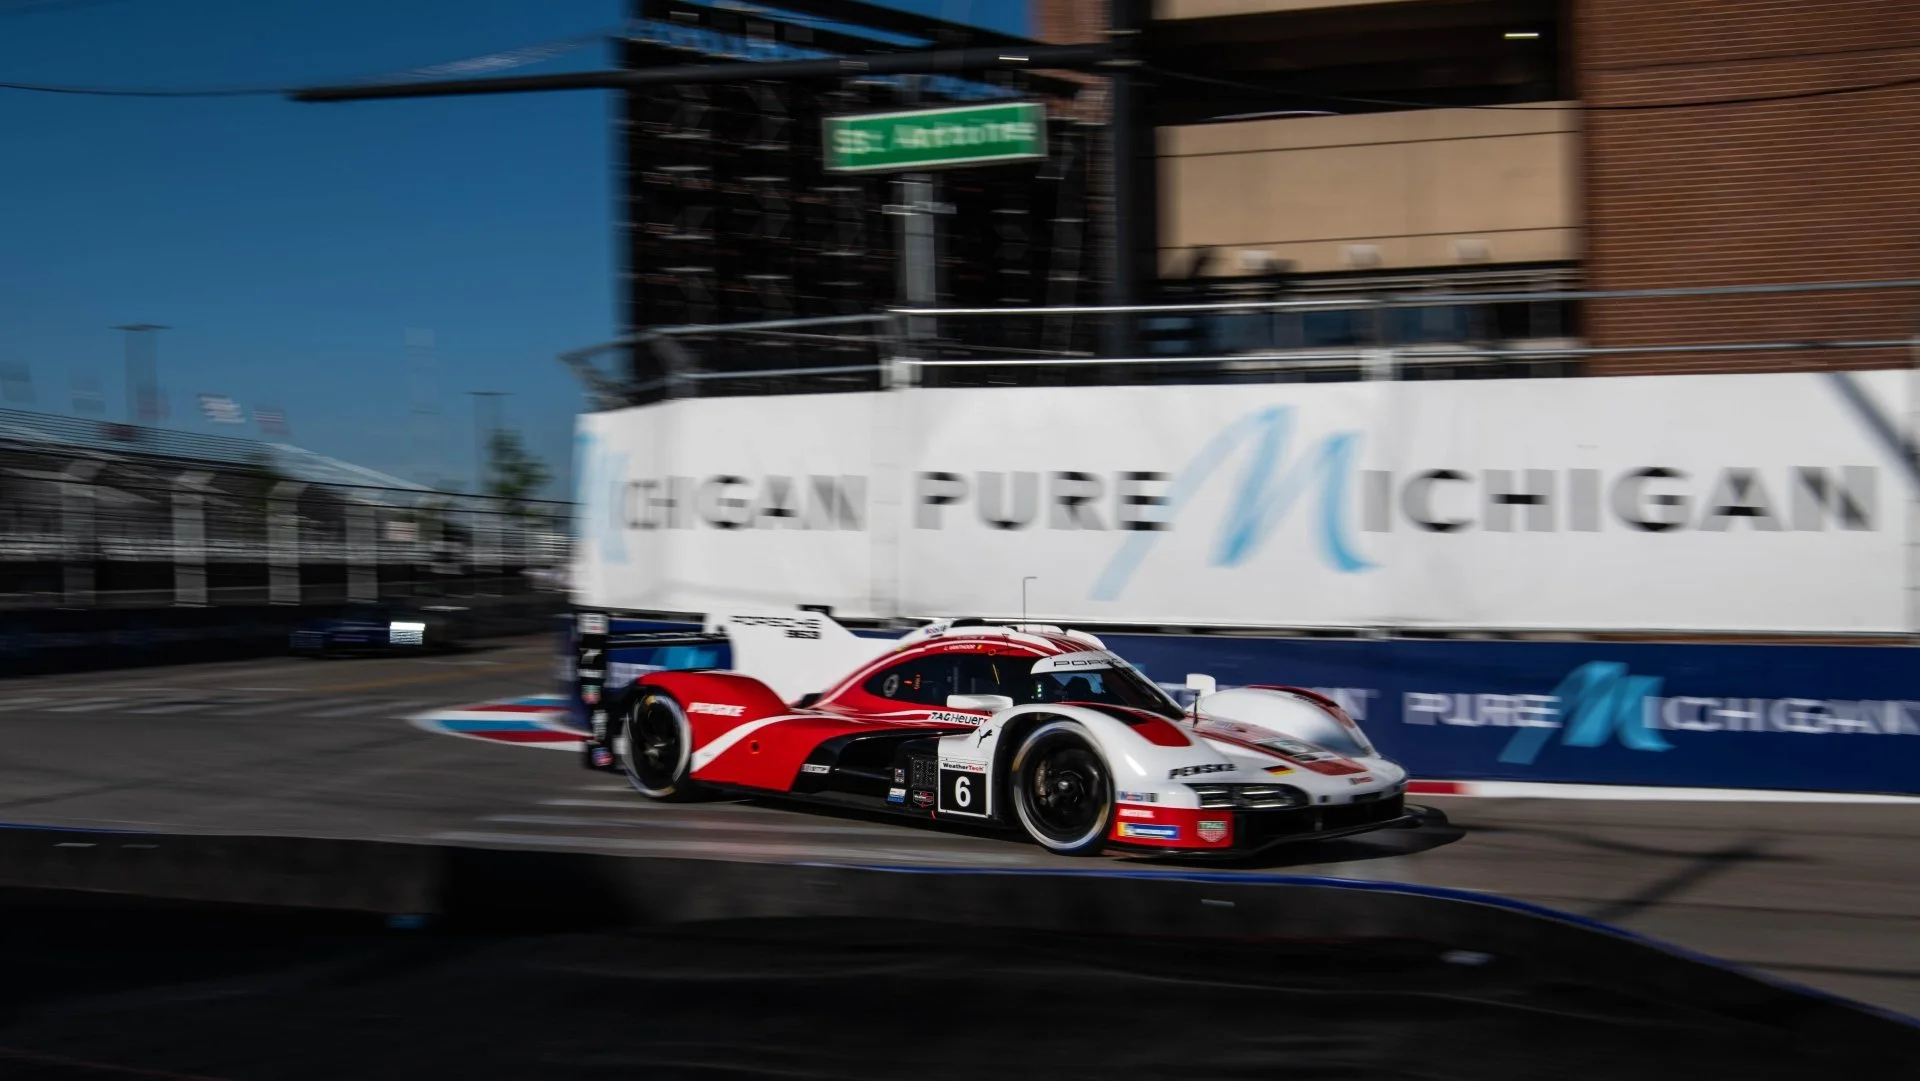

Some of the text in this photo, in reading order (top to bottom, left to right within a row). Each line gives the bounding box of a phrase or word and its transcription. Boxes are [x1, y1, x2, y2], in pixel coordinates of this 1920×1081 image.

[913, 470, 1174, 533] PURE
[1403, 692, 1562, 728] PURE
[1168, 763, 1237, 780] PENSKE
[955, 776, 970, 807] 6
